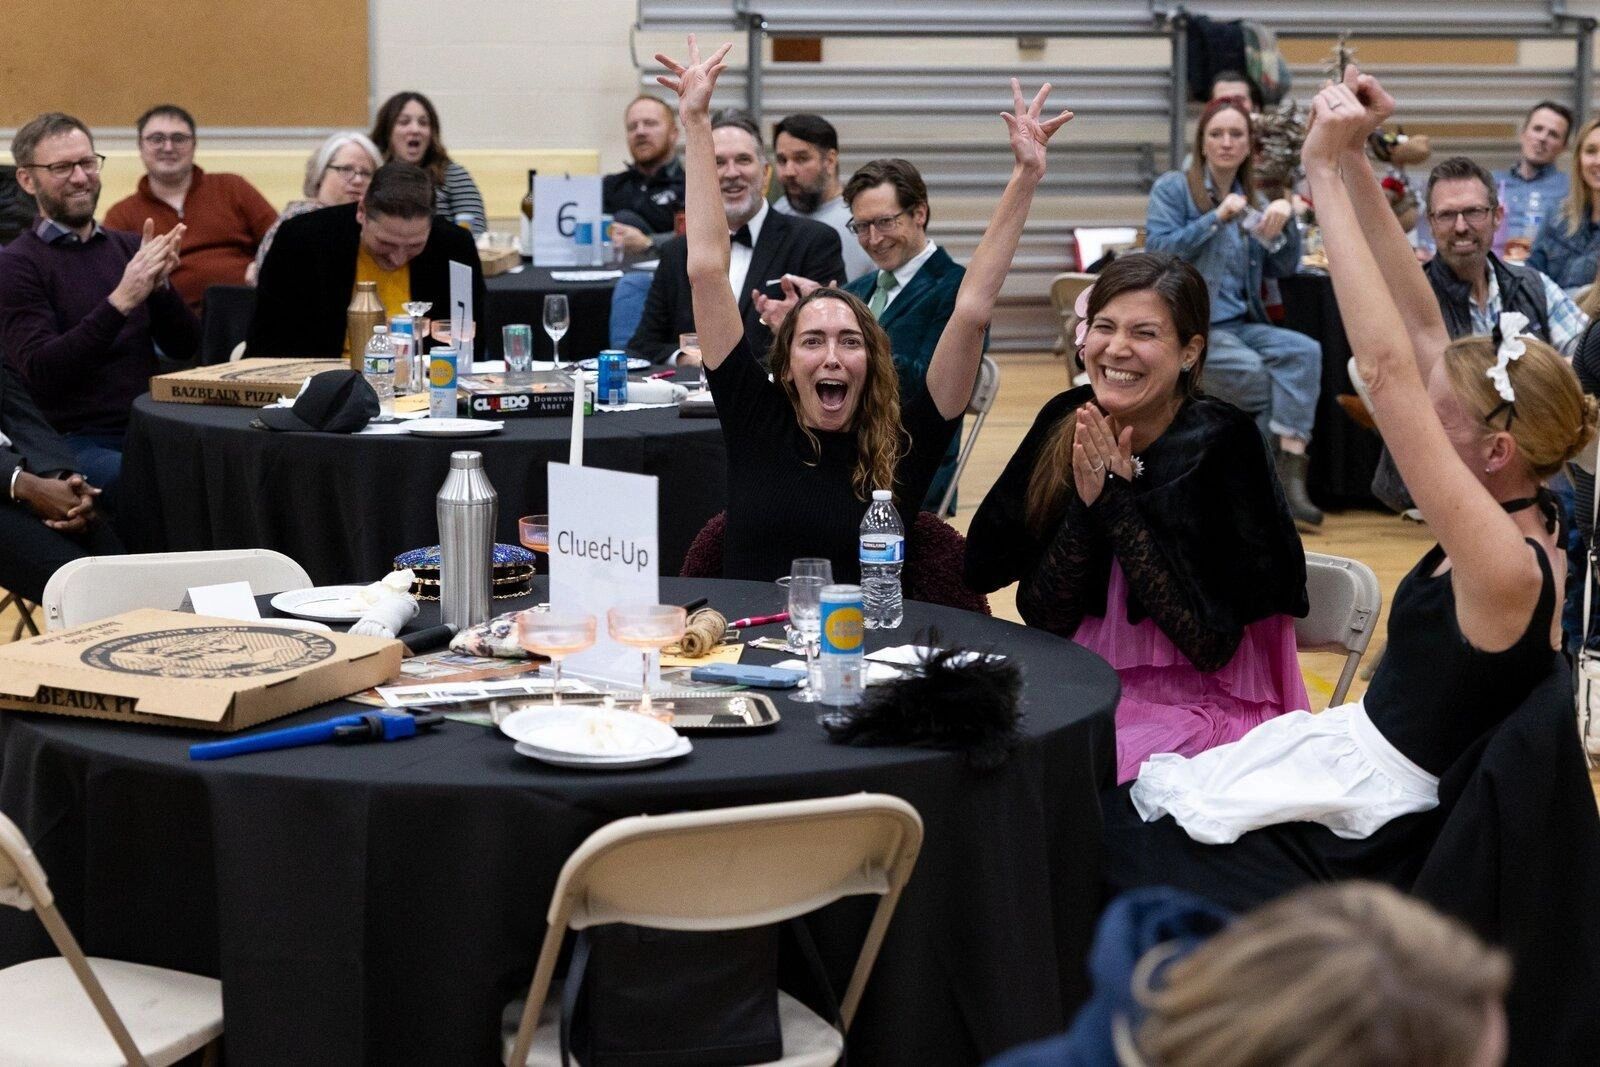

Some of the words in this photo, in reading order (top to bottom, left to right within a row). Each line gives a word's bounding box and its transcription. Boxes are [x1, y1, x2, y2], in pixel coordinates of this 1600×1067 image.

[556, 202, 579, 237] 6
[171, 386, 241, 401] BAZBEAUX
[557, 530, 649, 572] Clued-Up
